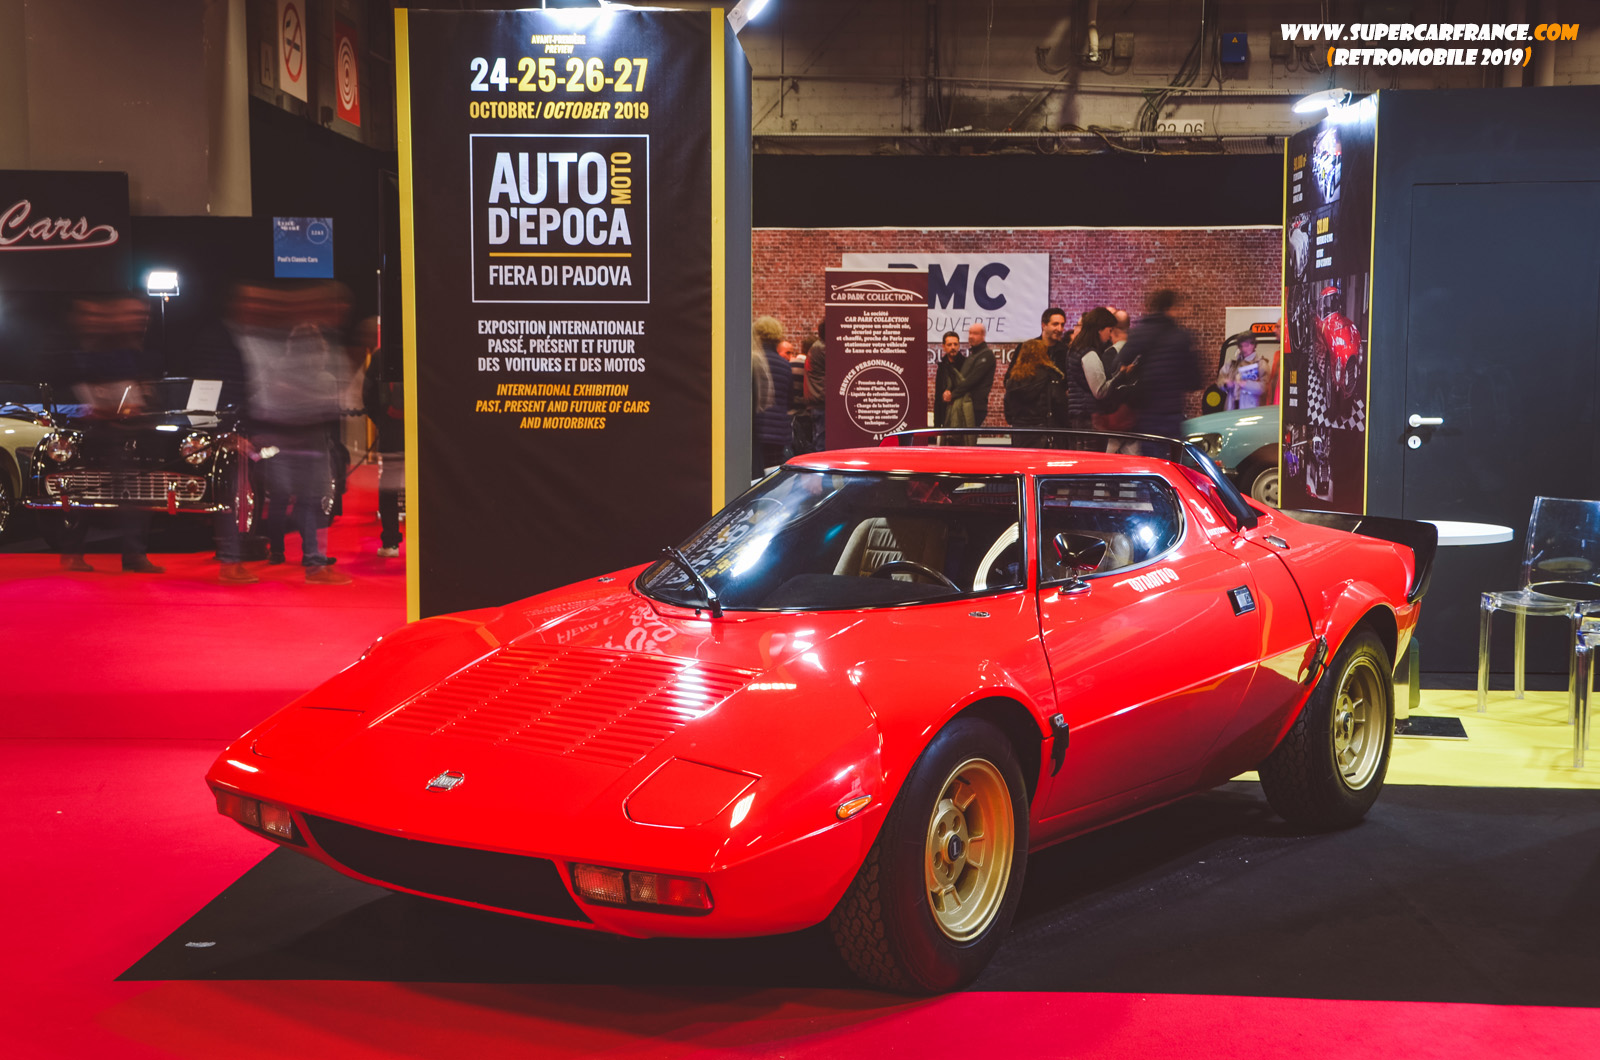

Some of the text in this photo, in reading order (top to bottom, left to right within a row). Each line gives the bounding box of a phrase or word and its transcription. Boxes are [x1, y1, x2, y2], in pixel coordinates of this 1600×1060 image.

[544, 45, 574, 54] PREVIEW
[470, 57, 648, 92] 24-25-26-27
[543, 101, 611, 119] OCTOBER
[614, 101, 649, 119] 2019
[488, 151, 608, 205] AUTO
[610, 151, 632, 205] MOTO
[0, 199, 116, 247] Cars
[488, 207, 632, 246] D'EPOCA
[489, 265, 632, 286] FIERA DI PADOVA
[888, 262, 1011, 311] MC
[830, 293, 914, 302] CAR PARK COLLECTION
[478, 320, 645, 335] EXPOSITION INTERNATIONALE
[488, 335, 635, 355] PASSÉ, PRÉSENT ET FUTUR
[478, 357, 645, 372] DES VOITURES ET DES MOTOS
[839, 359, 905, 396] SERVICE PERSONNALISÉ
[496, 383, 629, 397] INTERNATIONAL EXHIBITION
[475, 400, 650, 413] PAST, PRESENT AND FUTURE OF CARS
[520, 417, 606, 429] AND MOTORBIKES
